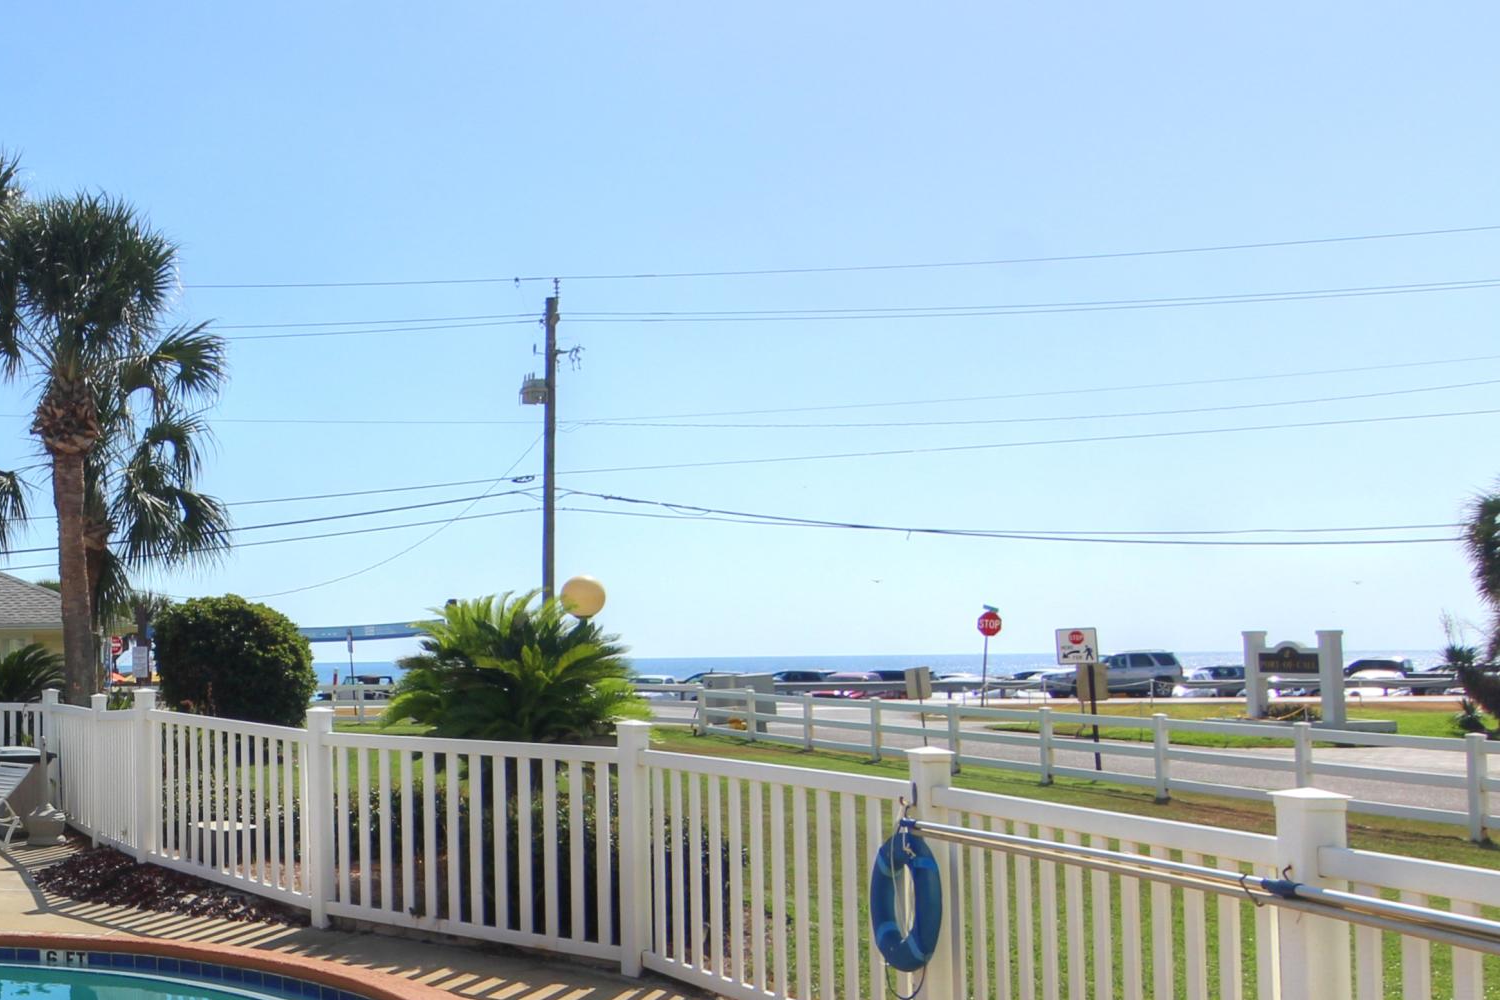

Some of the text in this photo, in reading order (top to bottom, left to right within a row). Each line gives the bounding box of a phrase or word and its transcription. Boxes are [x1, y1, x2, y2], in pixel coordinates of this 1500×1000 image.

[979, 619, 1000, 630] STOP
[46, 950, 85, 962] 6 FT
